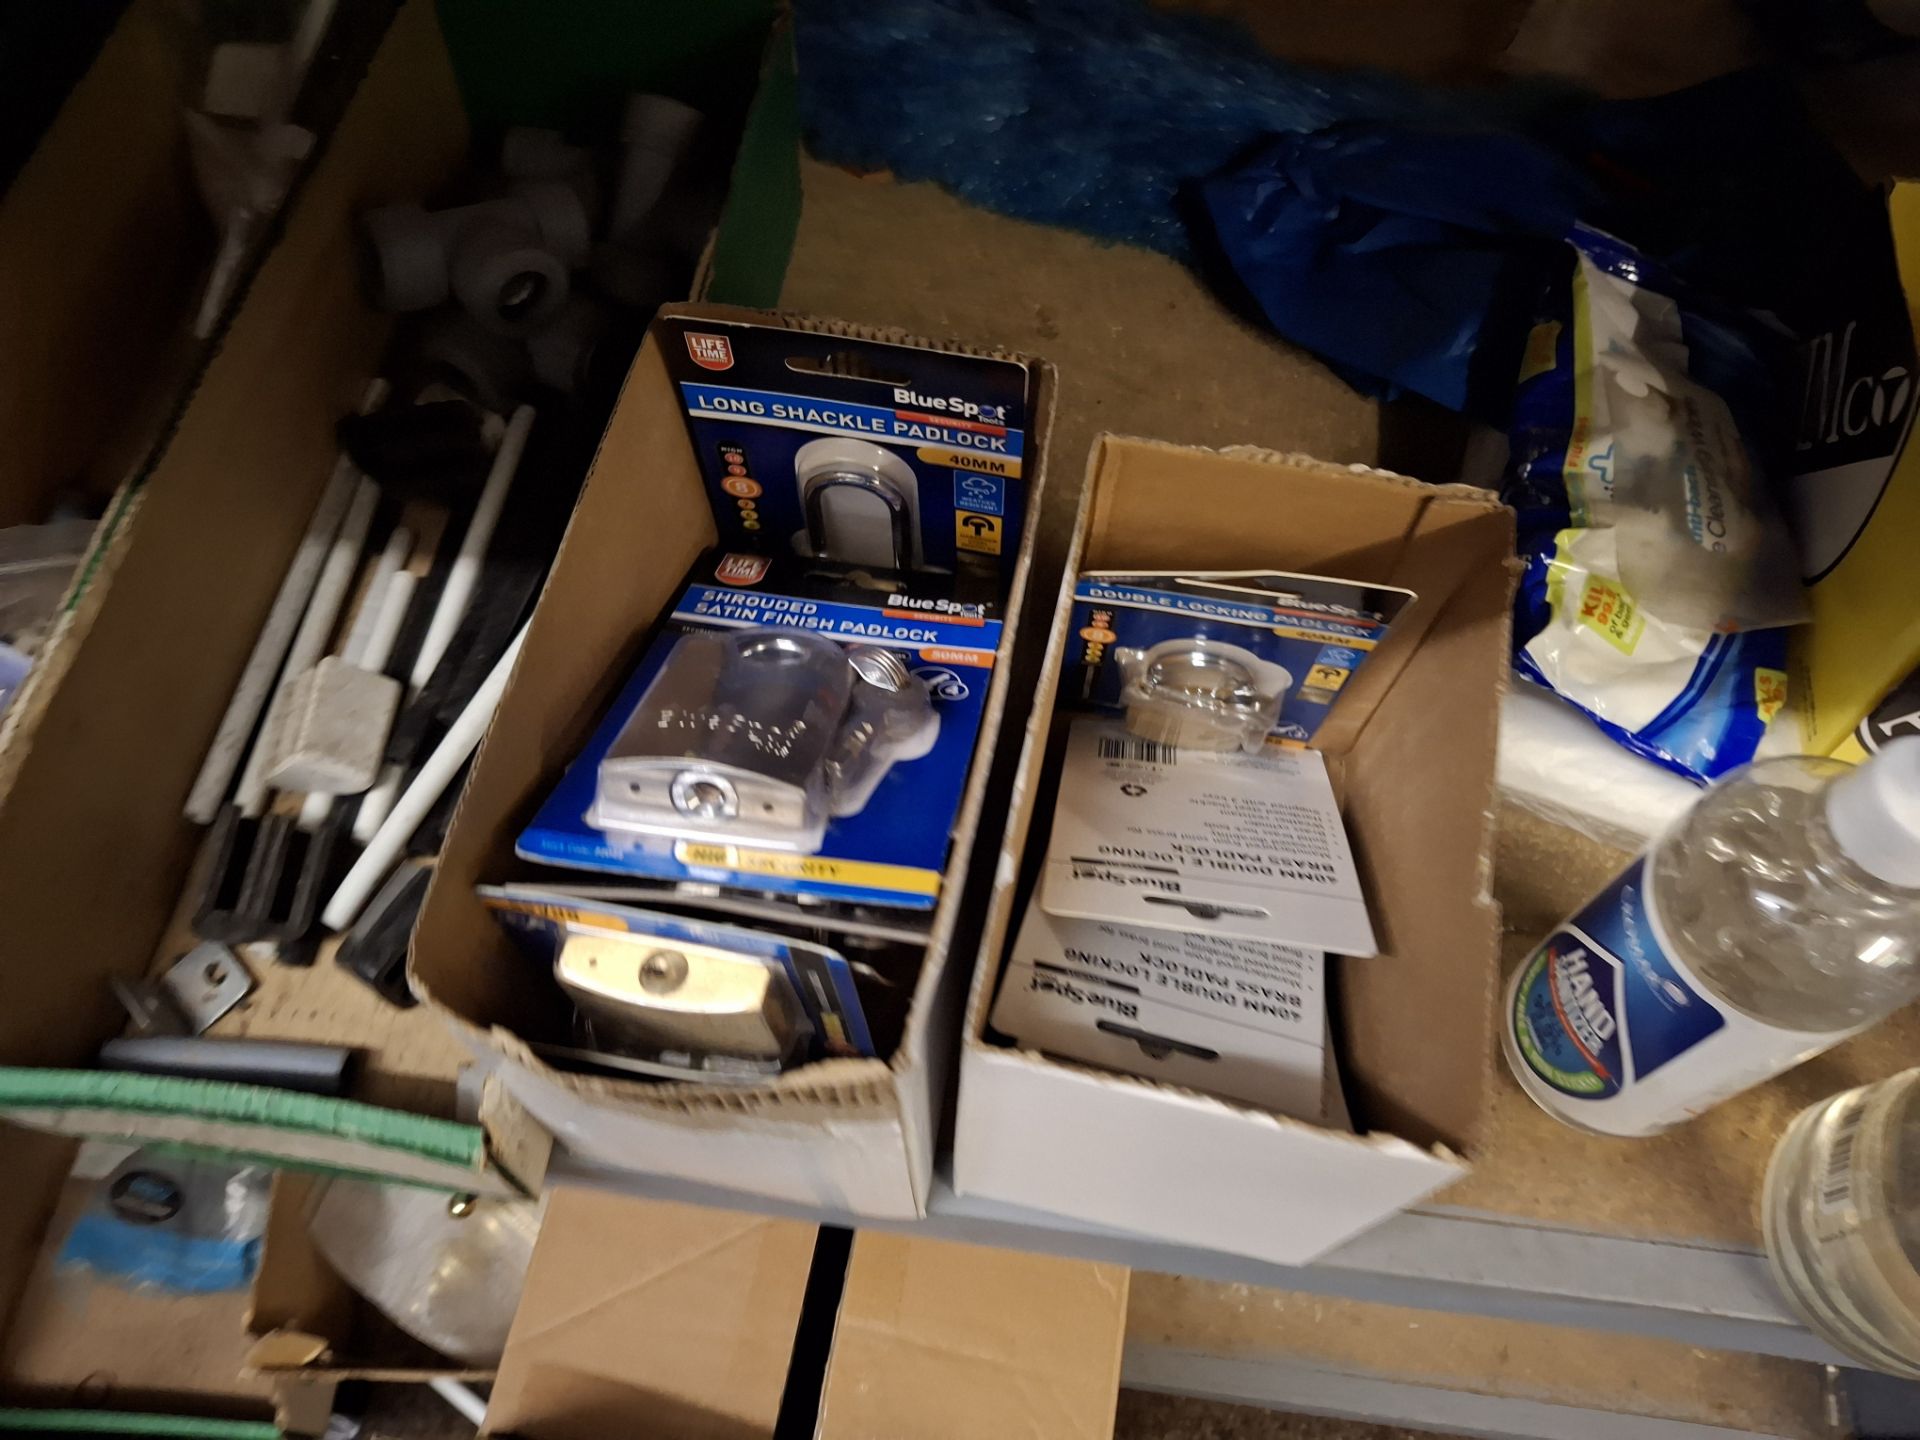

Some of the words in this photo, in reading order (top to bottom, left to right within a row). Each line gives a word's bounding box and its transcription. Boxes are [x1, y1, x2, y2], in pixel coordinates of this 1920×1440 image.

[691, 337, 725, 351] LIFE
[695, 348, 728, 360] TIME
[698, 394, 765, 415] LONG
[772, 402, 886, 432] SHACKLE
[893, 421, 1007, 452] PADLOCK
[949, 455, 1005, 473] 40MM
[725, 565, 760, 577] TIME
[727, 557, 762, 571] LIFE
[702, 590, 818, 615] SHROUDED
[1089, 587, 1172, 607] DOUBLE
[1177, 599, 1268, 622] LOCKING
[1273, 614, 1371, 638] PADLOCK
[694, 602, 758, 620] SATIN
[762, 610, 835, 632] FINISH
[839, 620, 939, 643] PADLOCK
[1098, 845, 1186, 865] LOCKING
[1170, 842, 1262, 863] PADLOCK
[1268, 854, 1336, 873] BRASS
[1193, 857, 1273, 876] DOUBLE
[1280, 868, 1338, 884] 40MM
[1064, 948, 1151, 982] LOCKING
[1140, 951, 1230, 989] PADLOCK
[1155, 972, 1237, 1007] DOUBLE
[1235, 978, 1302, 1009] BRASS
[1565, 946, 1617, 1042] HAND
[1242, 999, 1302, 1023] 40MM
